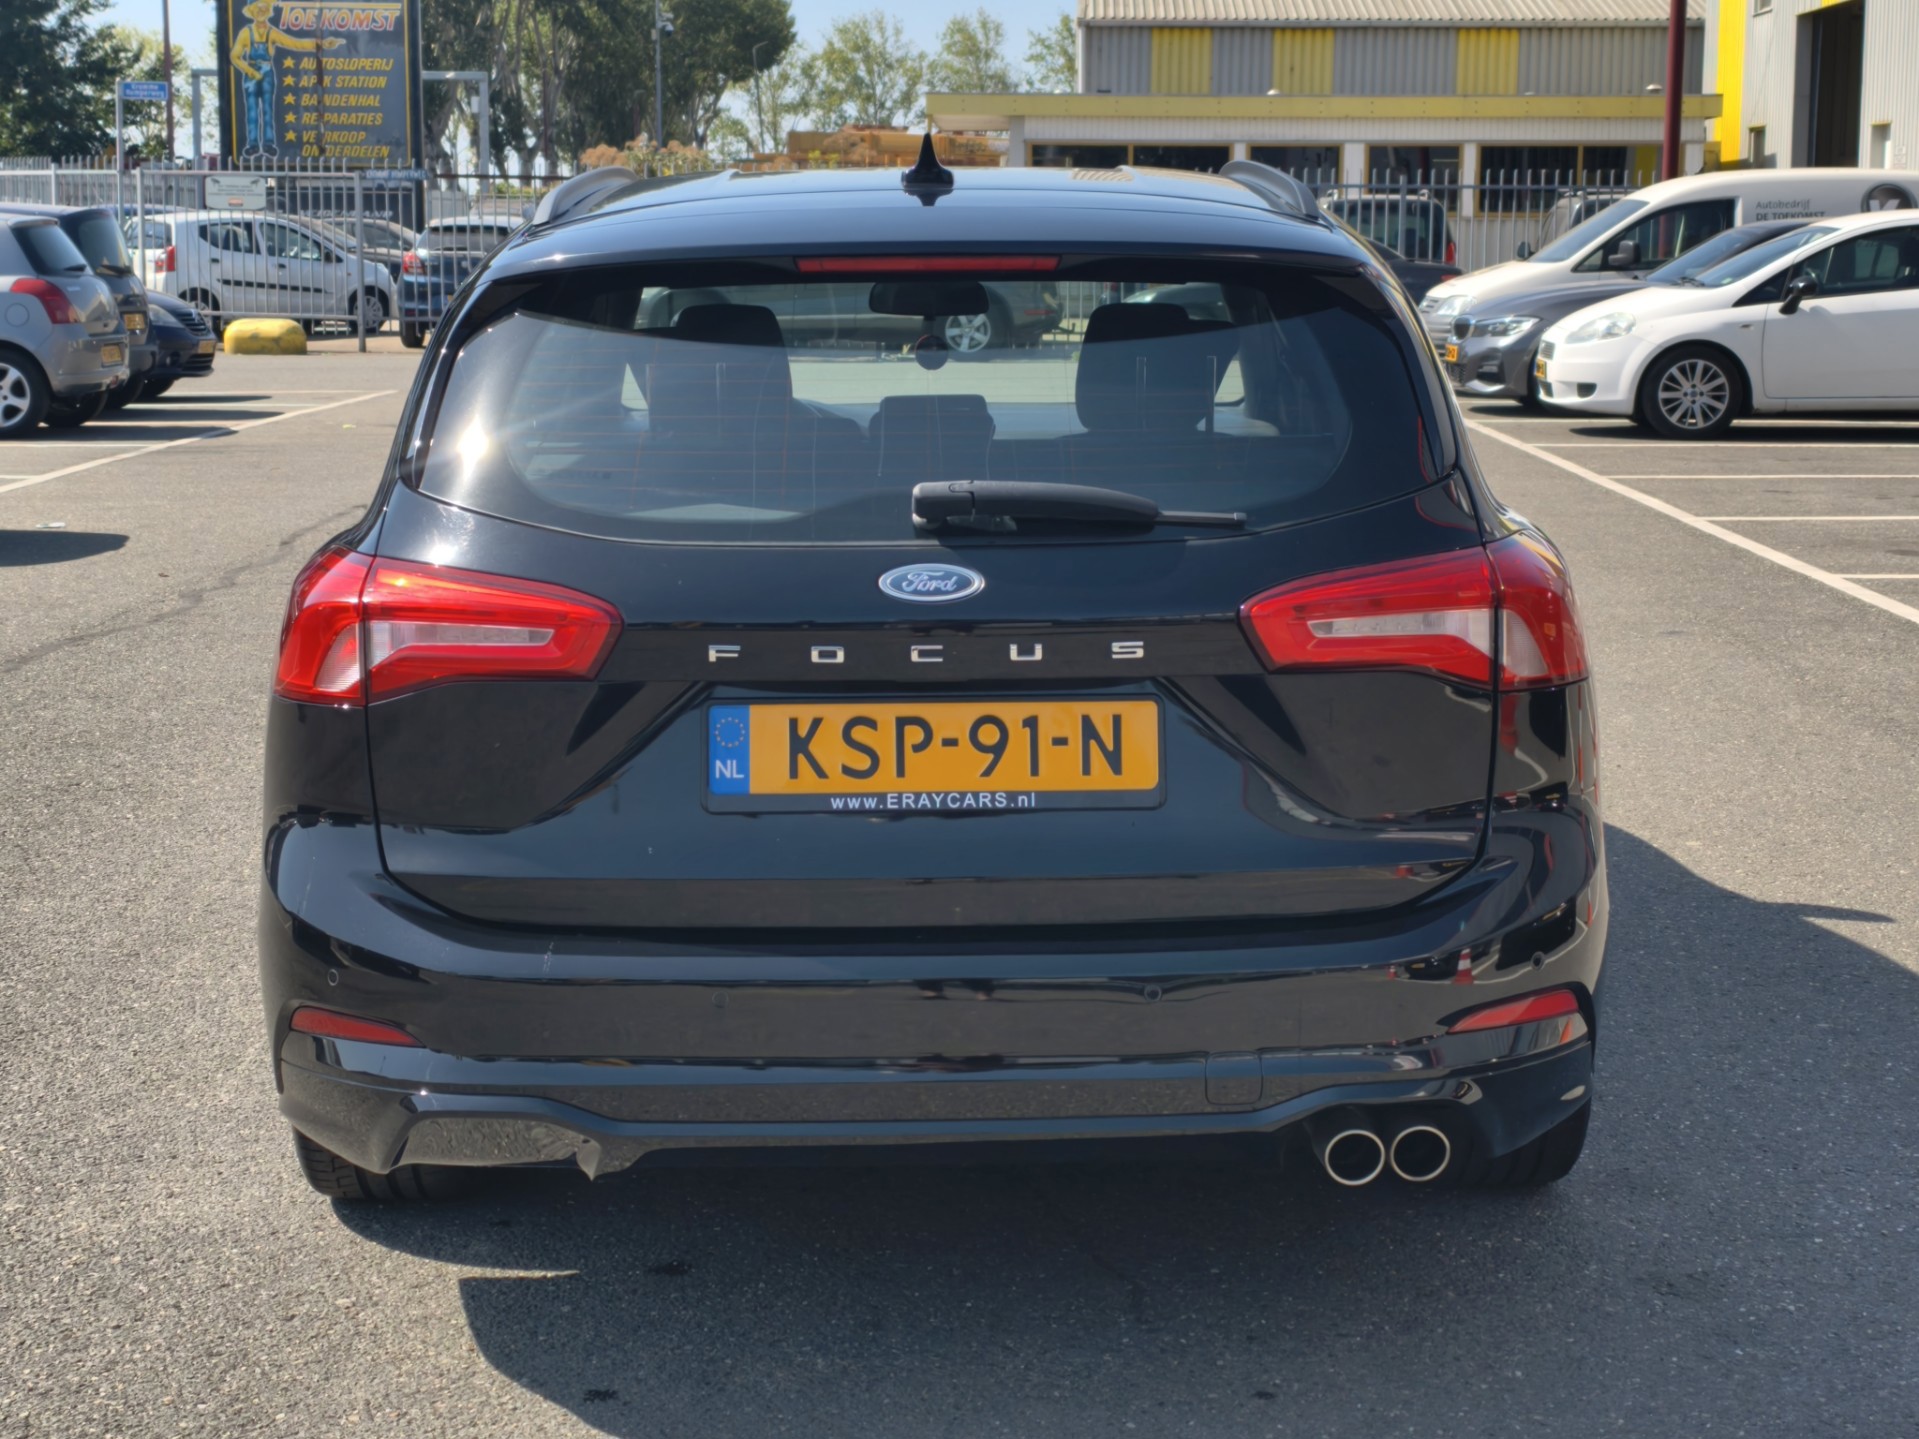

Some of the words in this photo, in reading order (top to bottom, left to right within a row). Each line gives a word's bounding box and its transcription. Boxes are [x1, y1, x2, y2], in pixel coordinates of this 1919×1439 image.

[335, 75, 388, 88] STATION
[301, 93, 381, 107] BANDENHAL
[302, 112, 383, 126] REPARATIES
[302, 130, 366, 143] VERKOOP
[1756, 199, 1810, 210] Autobedrijf
[1756, 212, 1769, 221] DE
[902, 571, 959, 592] Ford
[708, 641, 1145, 664] FOCUS
[715, 760, 744, 779] NL
[788, 714, 1123, 780] KSP-91-N
[831, 791, 1036, 810] www.ERAYCARS.nl
